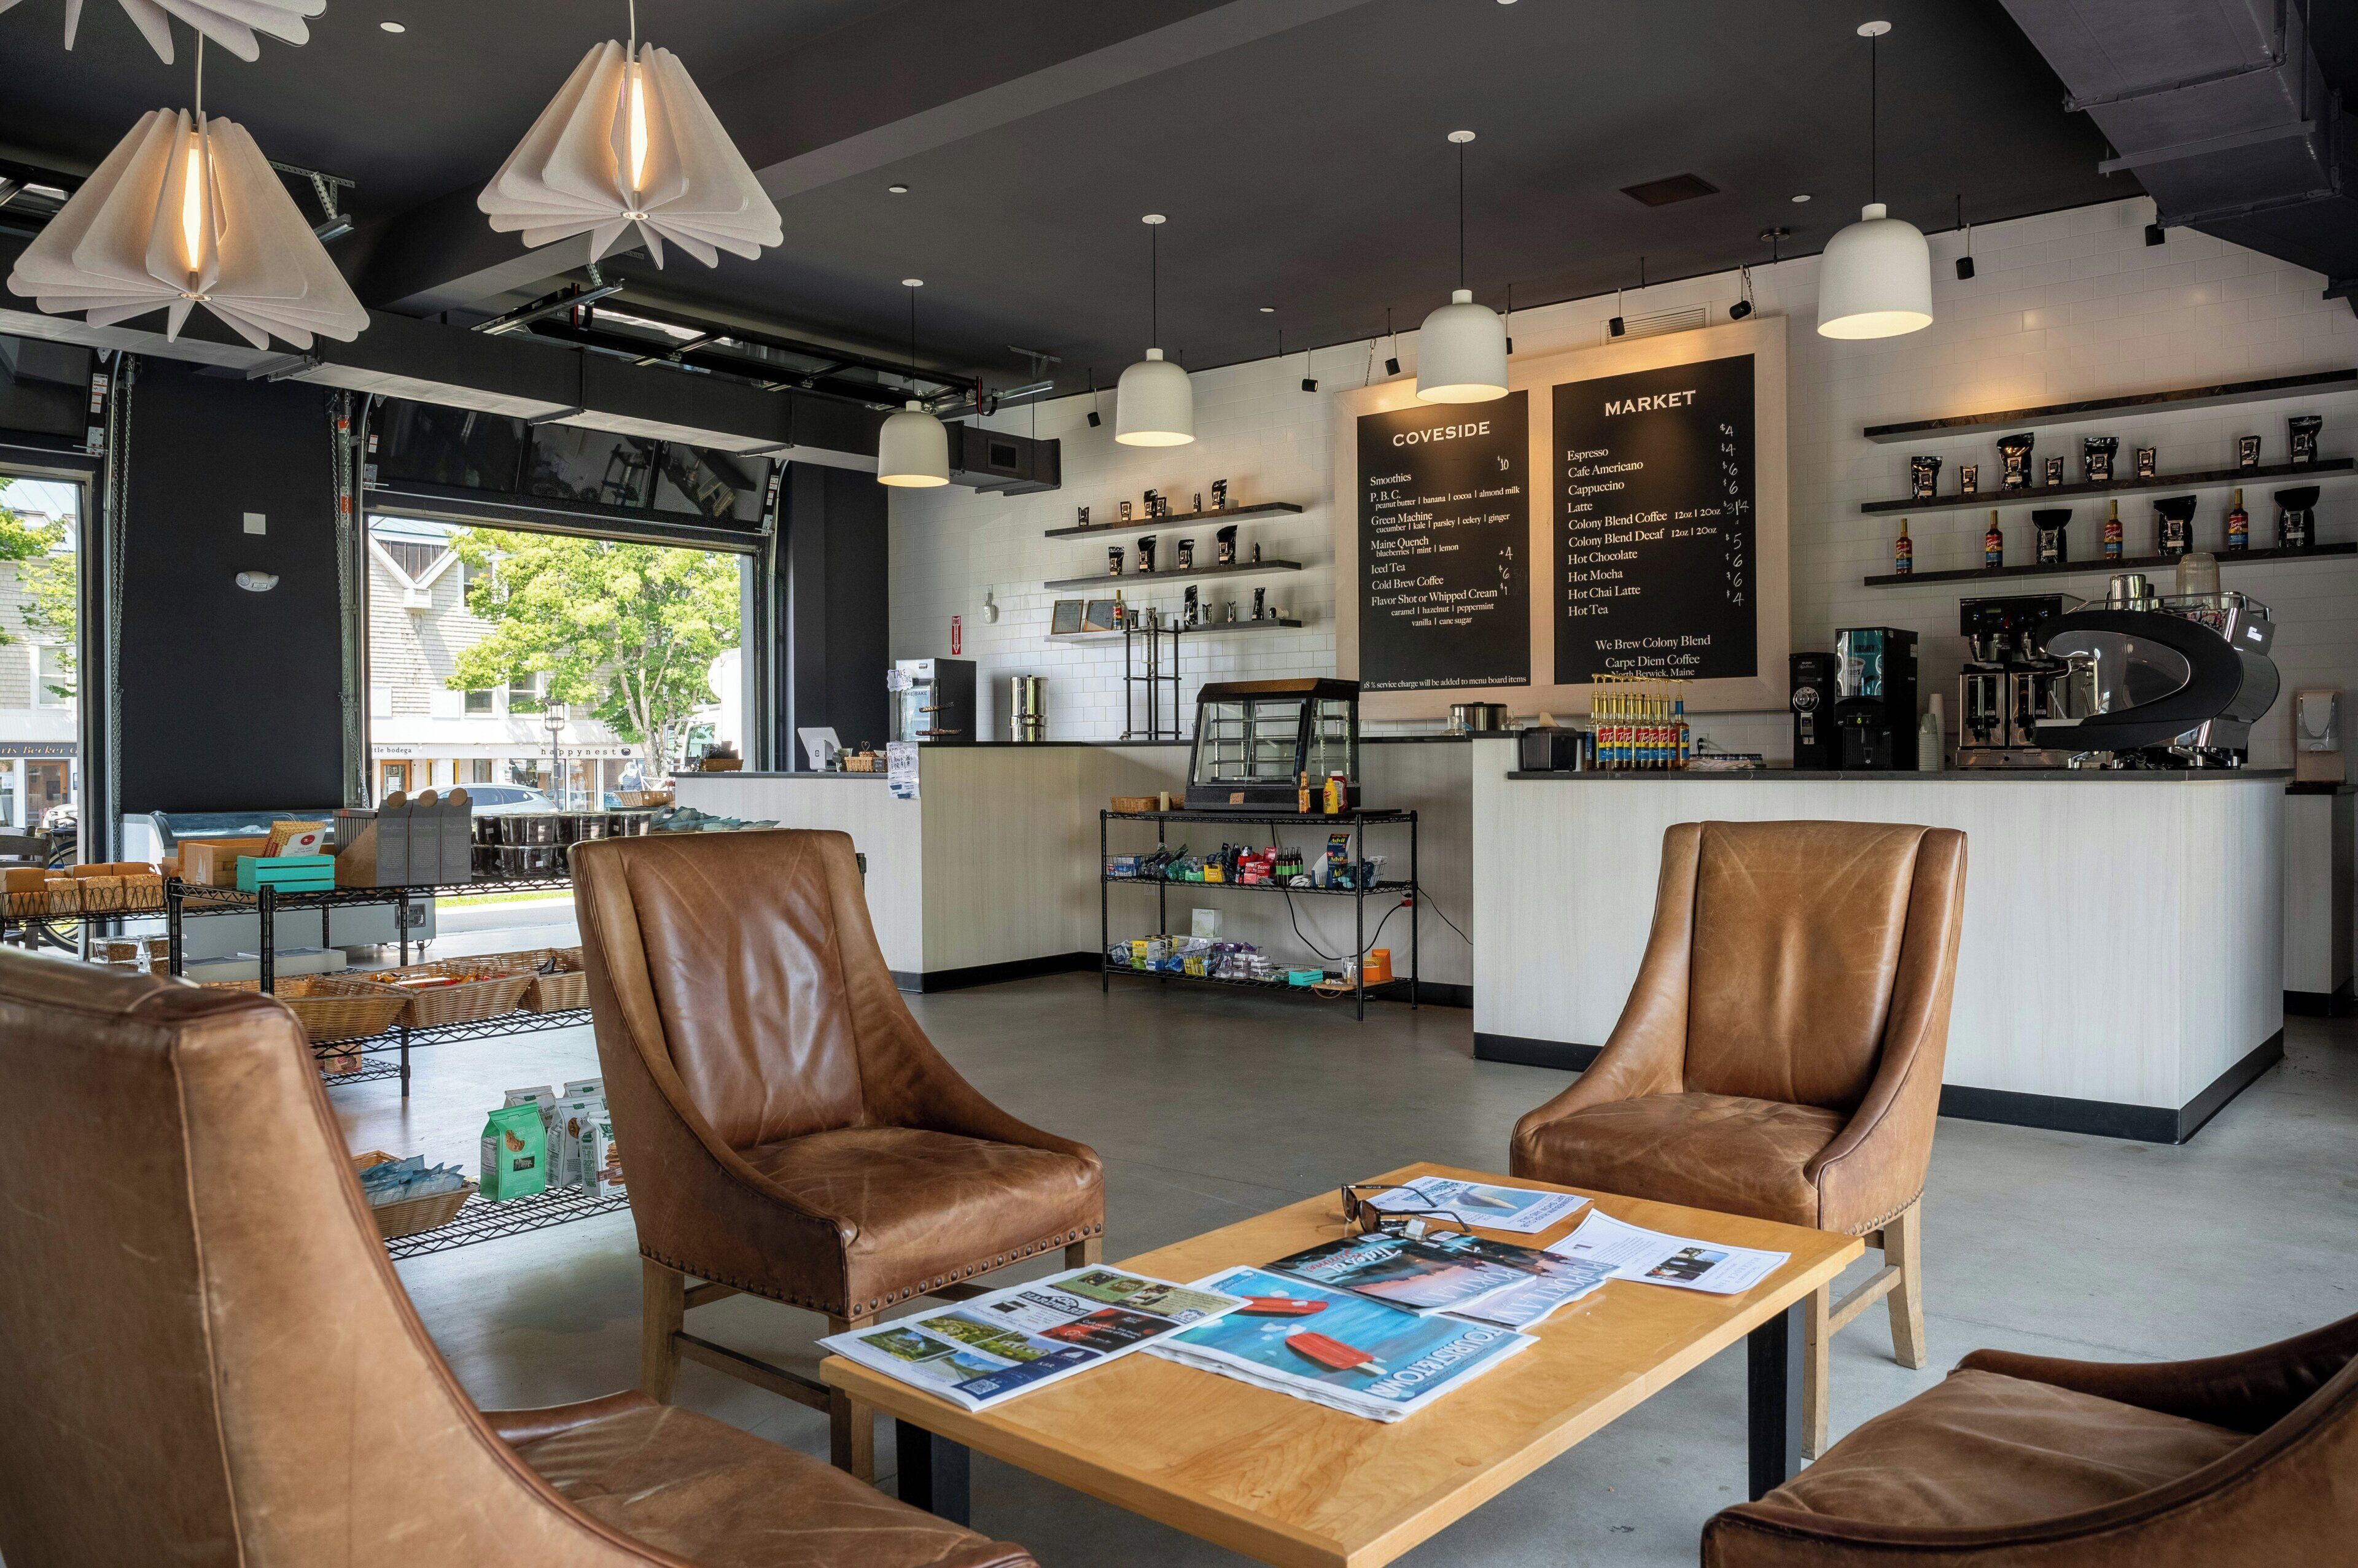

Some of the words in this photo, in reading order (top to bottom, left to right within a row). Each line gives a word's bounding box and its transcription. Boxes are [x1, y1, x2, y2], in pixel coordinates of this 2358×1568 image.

[1605, 389, 1696, 416] MARKET
[1393, 421, 1490, 446] COVESIDE
[1720, 423, 1733, 437] $4
[1567, 448, 1608, 462] Espresso
[1721, 443, 1736, 456] $4
[1497, 456, 1509, 471] $10
[1568, 467, 1590, 478] Cafe
[1592, 461, 1643, 476] Americano
[1722, 461, 1738, 476] $6
[1370, 473, 1412, 486] Smoothies
[1723, 479, 1738, 494] $6
[1568, 481, 1625, 497] Cappuccino
[1376, 500, 1396, 511] peanut
[1397, 498, 1415, 507] butter
[1423, 495, 1446, 504] banana
[1479, 488, 1504, 497] almond
[1505, 486, 1520, 494] milk
[1568, 502, 1593, 513] Latte
[1371, 515, 1395, 526] Green
[1398, 511, 1433, 523] Machine
[1376, 524, 1406, 534] cucumber
[1413, 521, 1426, 530] kale
[1433, 519, 1455, 529] parsley
[1463, 516, 1481, 525] celery
[1488, 513, 1510, 524] ginger
[1568, 519, 1603, 530] Colony
[1605, 514, 1633, 527] Blend
[1635, 511, 1667, 524] Coffee
[1675, 511, 1692, 519] 12oz
[1700, 508, 1721, 516] 20oz
[2230, 519, 2247, 529] Torani
[1568, 536, 1602, 548] Colony
[1605, 531, 1632, 544] Blend
[1635, 529, 1665, 541] Decaf
[1671, 529, 1689, 537] 12oz
[2104, 527, 2121, 537] Torani
[1371, 540, 1396, 549] Maine
[1397, 536, 1429, 549] Quench
[1726, 534, 1741, 549] $5
[1986, 538, 2001, 548] Torani
[1376, 549, 1409, 557] blueberries
[1439, 543, 1459, 553] lemon
[1568, 554, 1587, 565] Hot
[1589, 550, 1638, 562] Chocolate
[1725, 553, 1743, 567] $6
[1371, 564, 1388, 574] Iced
[1389, 563, 1406, 572] Tea
[1372, 580, 1391, 590] Cold
[1393, 579, 1415, 589] Brew
[1417, 575, 1444, 587] Coffee
[1568, 572, 1588, 583] Hot
[1590, 569, 1623, 580] Mocha
[1726, 572, 1743, 587] $6
[1372, 596, 1396, 606] Flavor
[1398, 594, 1417, 604] Shot
[1429, 589, 1466, 604] Whipped
[1468, 589, 1498, 599] Cream
[1568, 589, 1588, 600] Hot
[1589, 587, 1612, 598] Chai
[1614, 586, 1641, 596] Latte
[1726, 589, 1745, 607] $4
[1422, 605, 1449, 614] hazelnut
[1457, 603, 1494, 613] peppermint
[1568, 606, 1588, 616] Hot
[1589, 604, 1608, 615] Tea
[1412, 618, 1431, 626] vanilla
[1454, 616, 1473, 626] sugar
[1595, 640, 1613, 650] We
[1614, 639, 1640, 650] Brew
[1643, 637, 1678, 649] Colony
[1681, 634, 1711, 646] Blend
[1605, 657, 1635, 669] Carpe
[1637, 656, 1665, 666] Diem
[1667, 653, 1700, 666] Coffee
[891, 669, 906, 679] TAKE
[1670, 668, 1695, 677] Maine
[1398, 679, 1418, 689] charge
[1419, 678, 1431, 687] will
[1488, 675, 1508, 684] board
[23, 745, 66, 754] Becker
